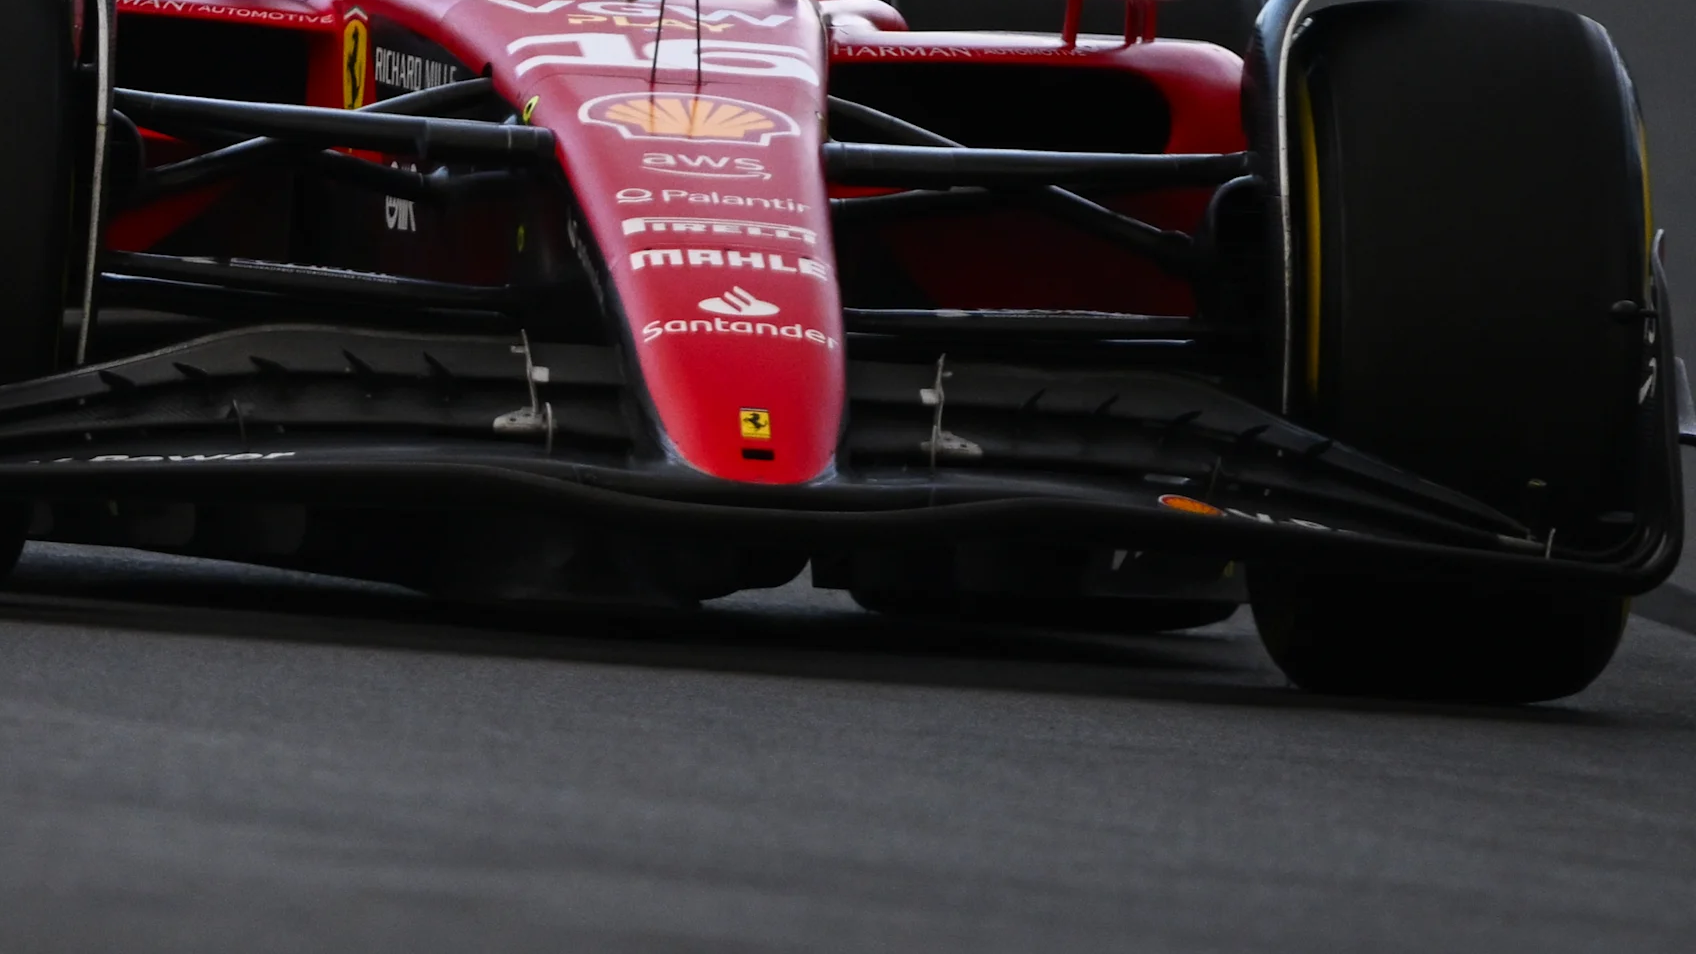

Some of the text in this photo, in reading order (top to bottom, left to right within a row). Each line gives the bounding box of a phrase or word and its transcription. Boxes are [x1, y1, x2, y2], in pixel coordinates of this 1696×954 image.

[197, 3, 334, 24] AUTOMOTIVE
[568, 14, 735, 33] PLAY
[506, 32, 820, 87] 16
[833, 44, 1087, 58] HARMAN AUTOMOTIVE
[375, 46, 421, 92] RICHARD
[642, 152, 765, 172] aws
[661, 189, 812, 213] Palantir
[621, 217, 818, 245] PIRELLI
[630, 248, 832, 282] MAHLE
[642, 317, 839, 349] Santander
